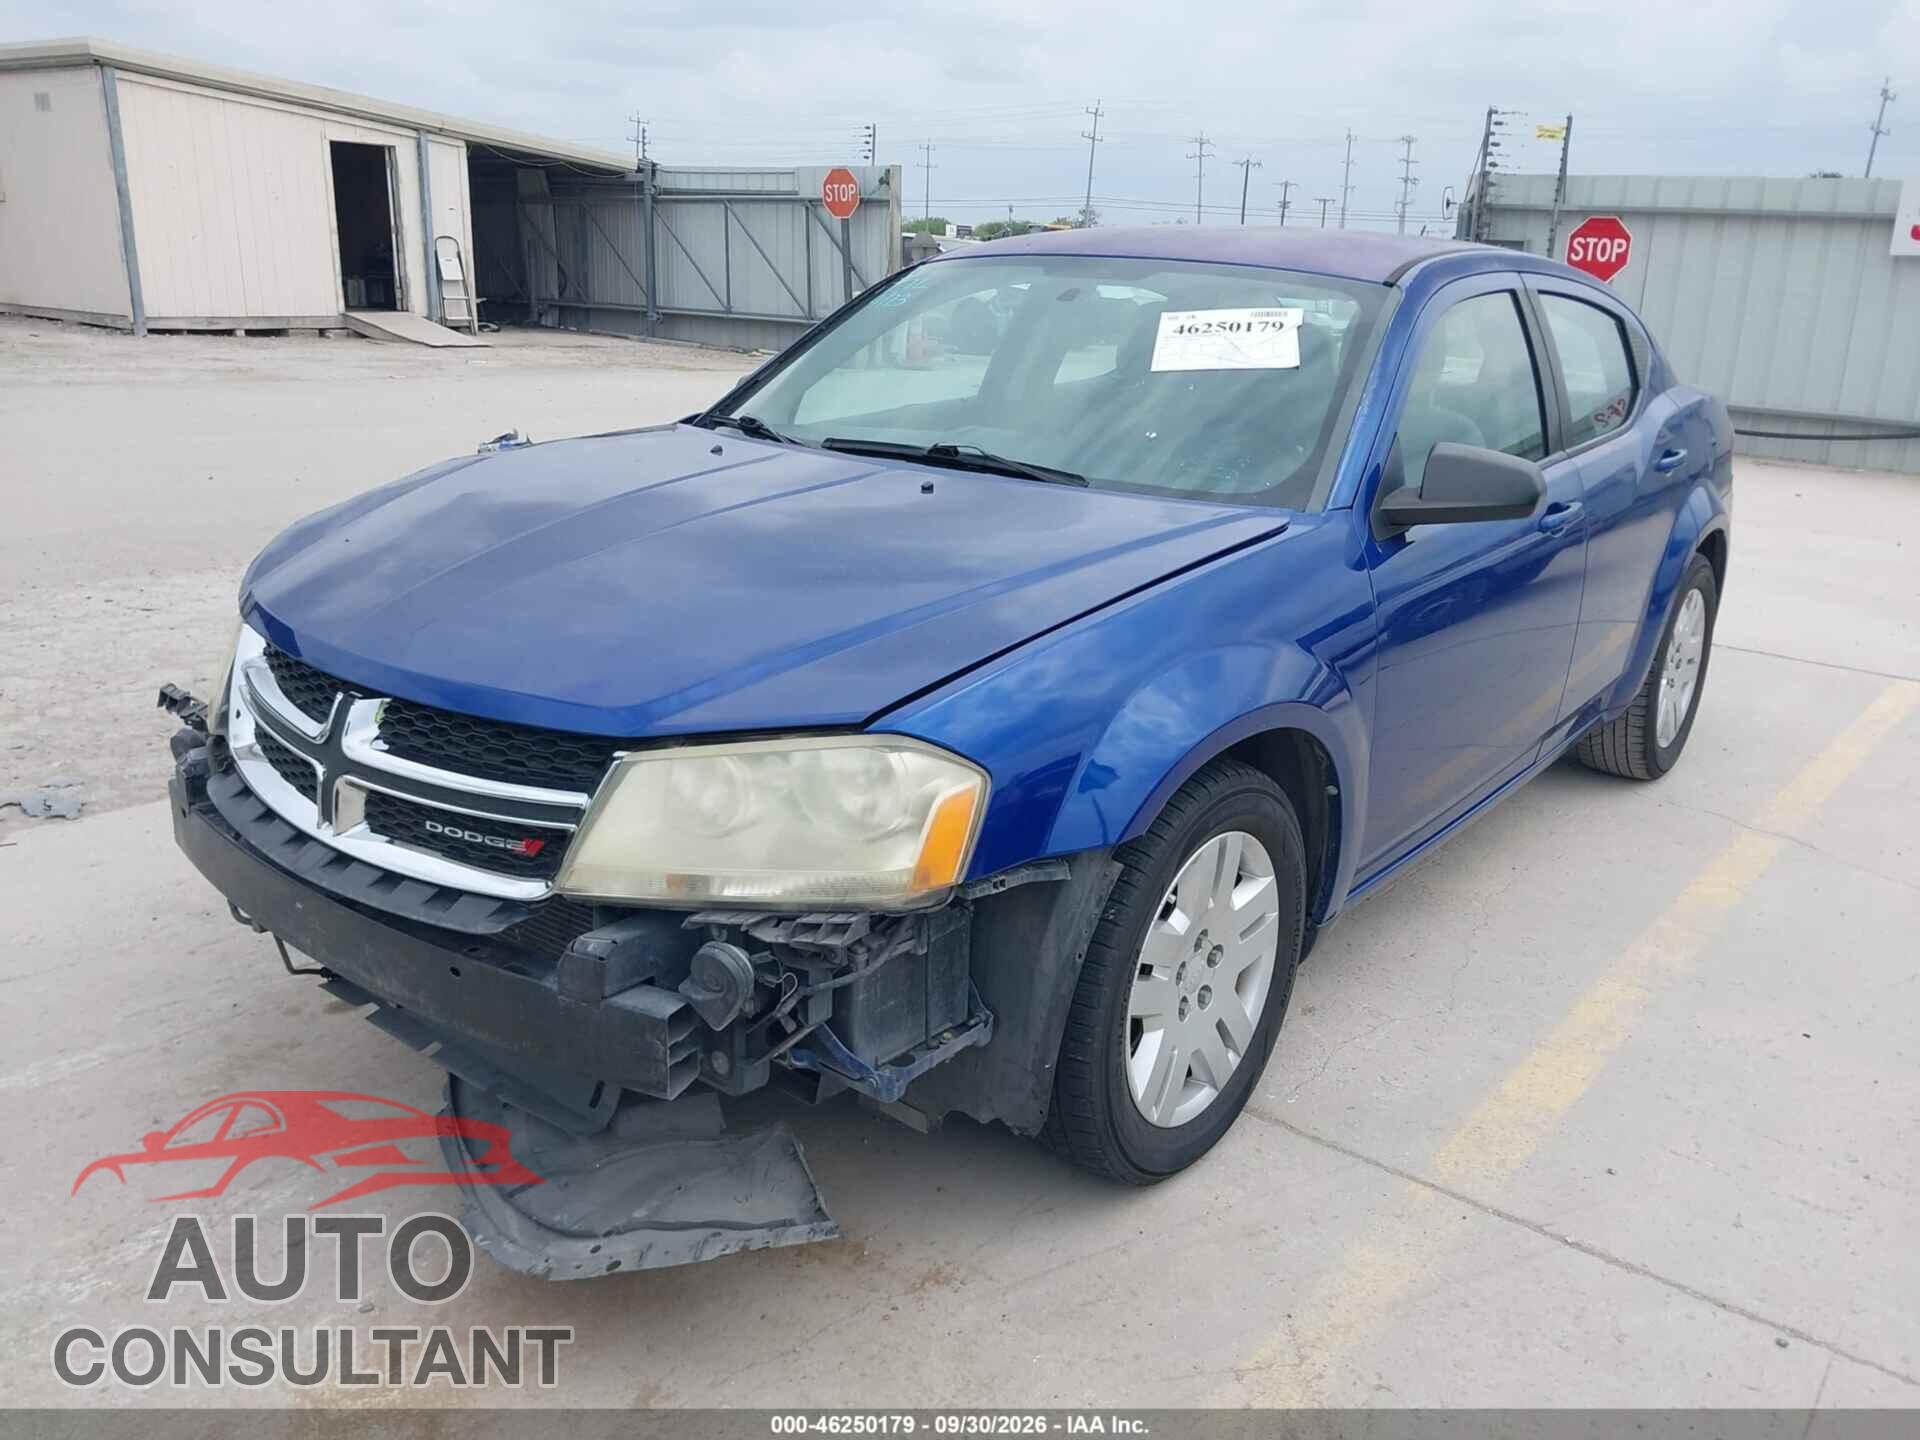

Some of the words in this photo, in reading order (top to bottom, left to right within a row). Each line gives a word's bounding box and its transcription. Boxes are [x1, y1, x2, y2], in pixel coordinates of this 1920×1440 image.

[825, 183, 856, 202] STOP
[1570, 236, 1627, 263] STOP
[1172, 320, 1285, 335] 46250179
[425, 820, 527, 853] DODGE
